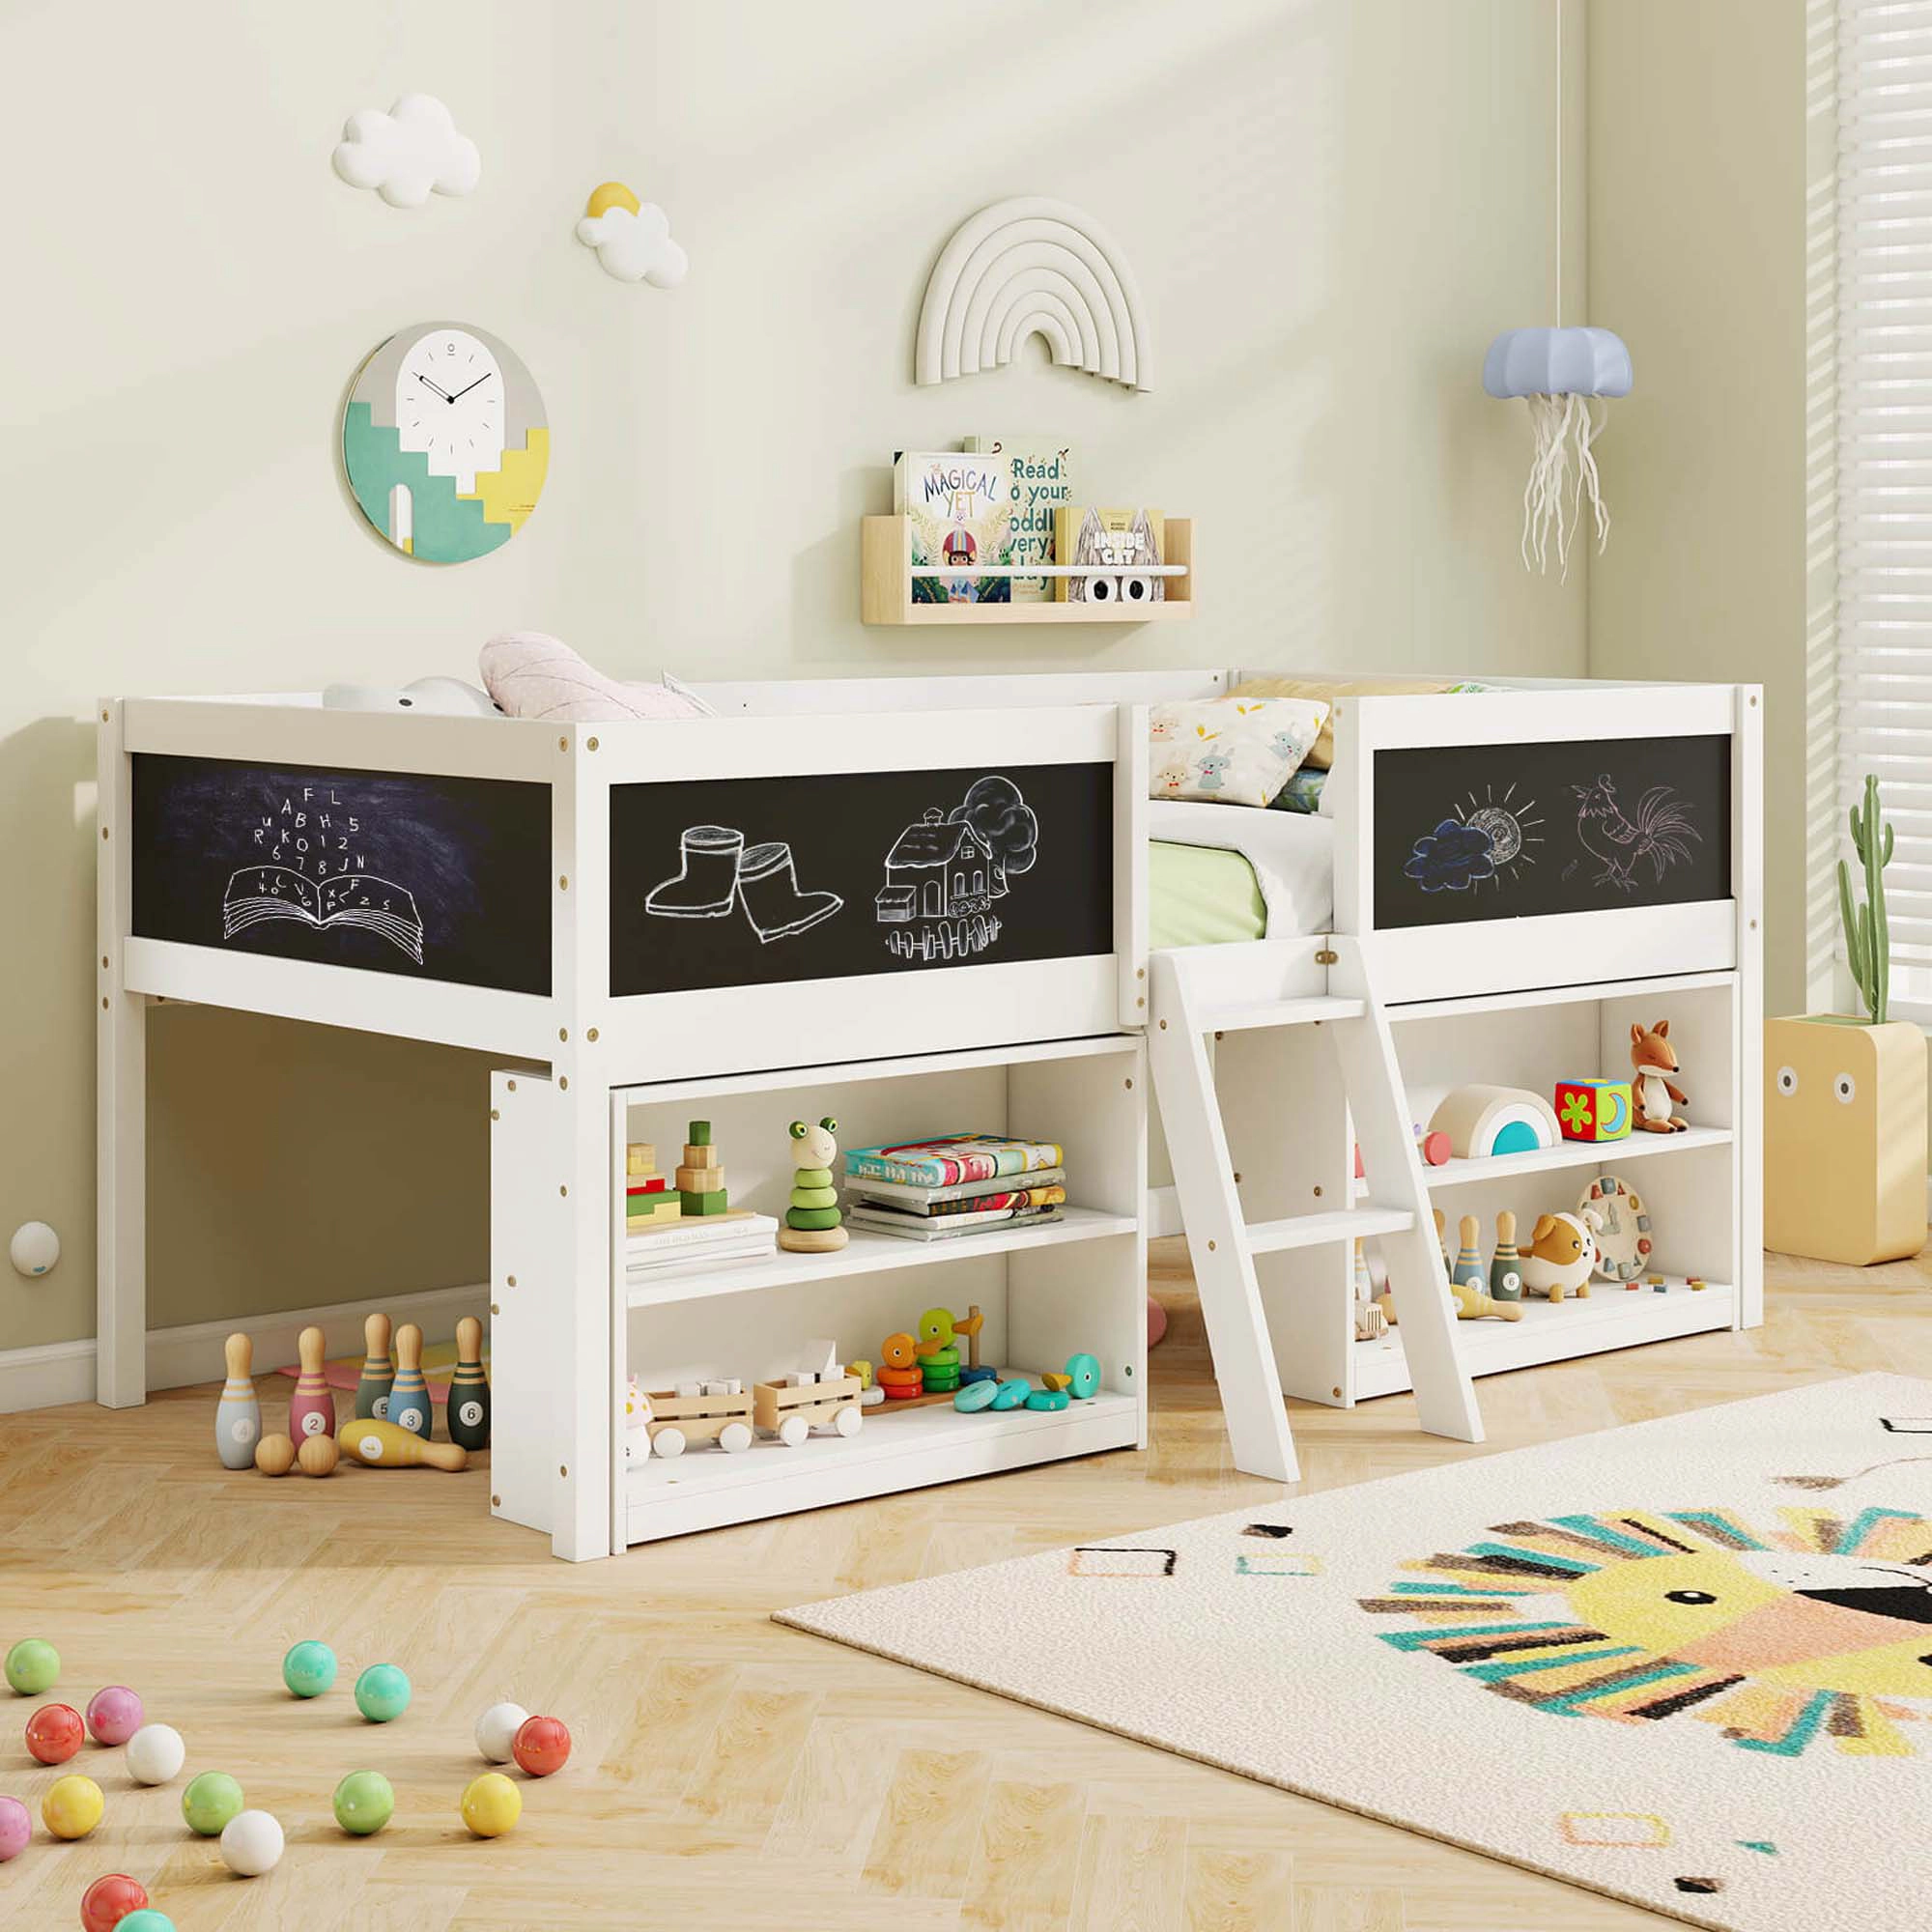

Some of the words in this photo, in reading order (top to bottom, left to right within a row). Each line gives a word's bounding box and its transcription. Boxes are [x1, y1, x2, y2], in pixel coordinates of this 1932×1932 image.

[1011, 458, 1060, 480] Read
[923, 469, 997, 502] MAGICAL
[1010, 485, 1021, 501] o
[1028, 486, 1067, 506] your
[943, 492, 976, 518] YET
[1009, 508, 1054, 532] oddl
[1009, 537, 1049, 559] very
[303, 787, 315, 802] F
[330, 789, 342, 806] L
[280, 798, 292, 815] A
[295, 811, 307, 829] B
[319, 813, 331, 829] H
[254, 829, 265, 844] R
[337, 837, 348, 850] 2
[271, 845, 281, 861] 6
[296, 857, 304, 870] 7
[318, 860, 327, 874] 8
[338, 857, 349, 872] J
[350, 878, 360, 891] F
[407, 1414, 415, 1427] 3
[468, 1407, 476, 1420] 6
[309, 1418, 319, 1431] 2
